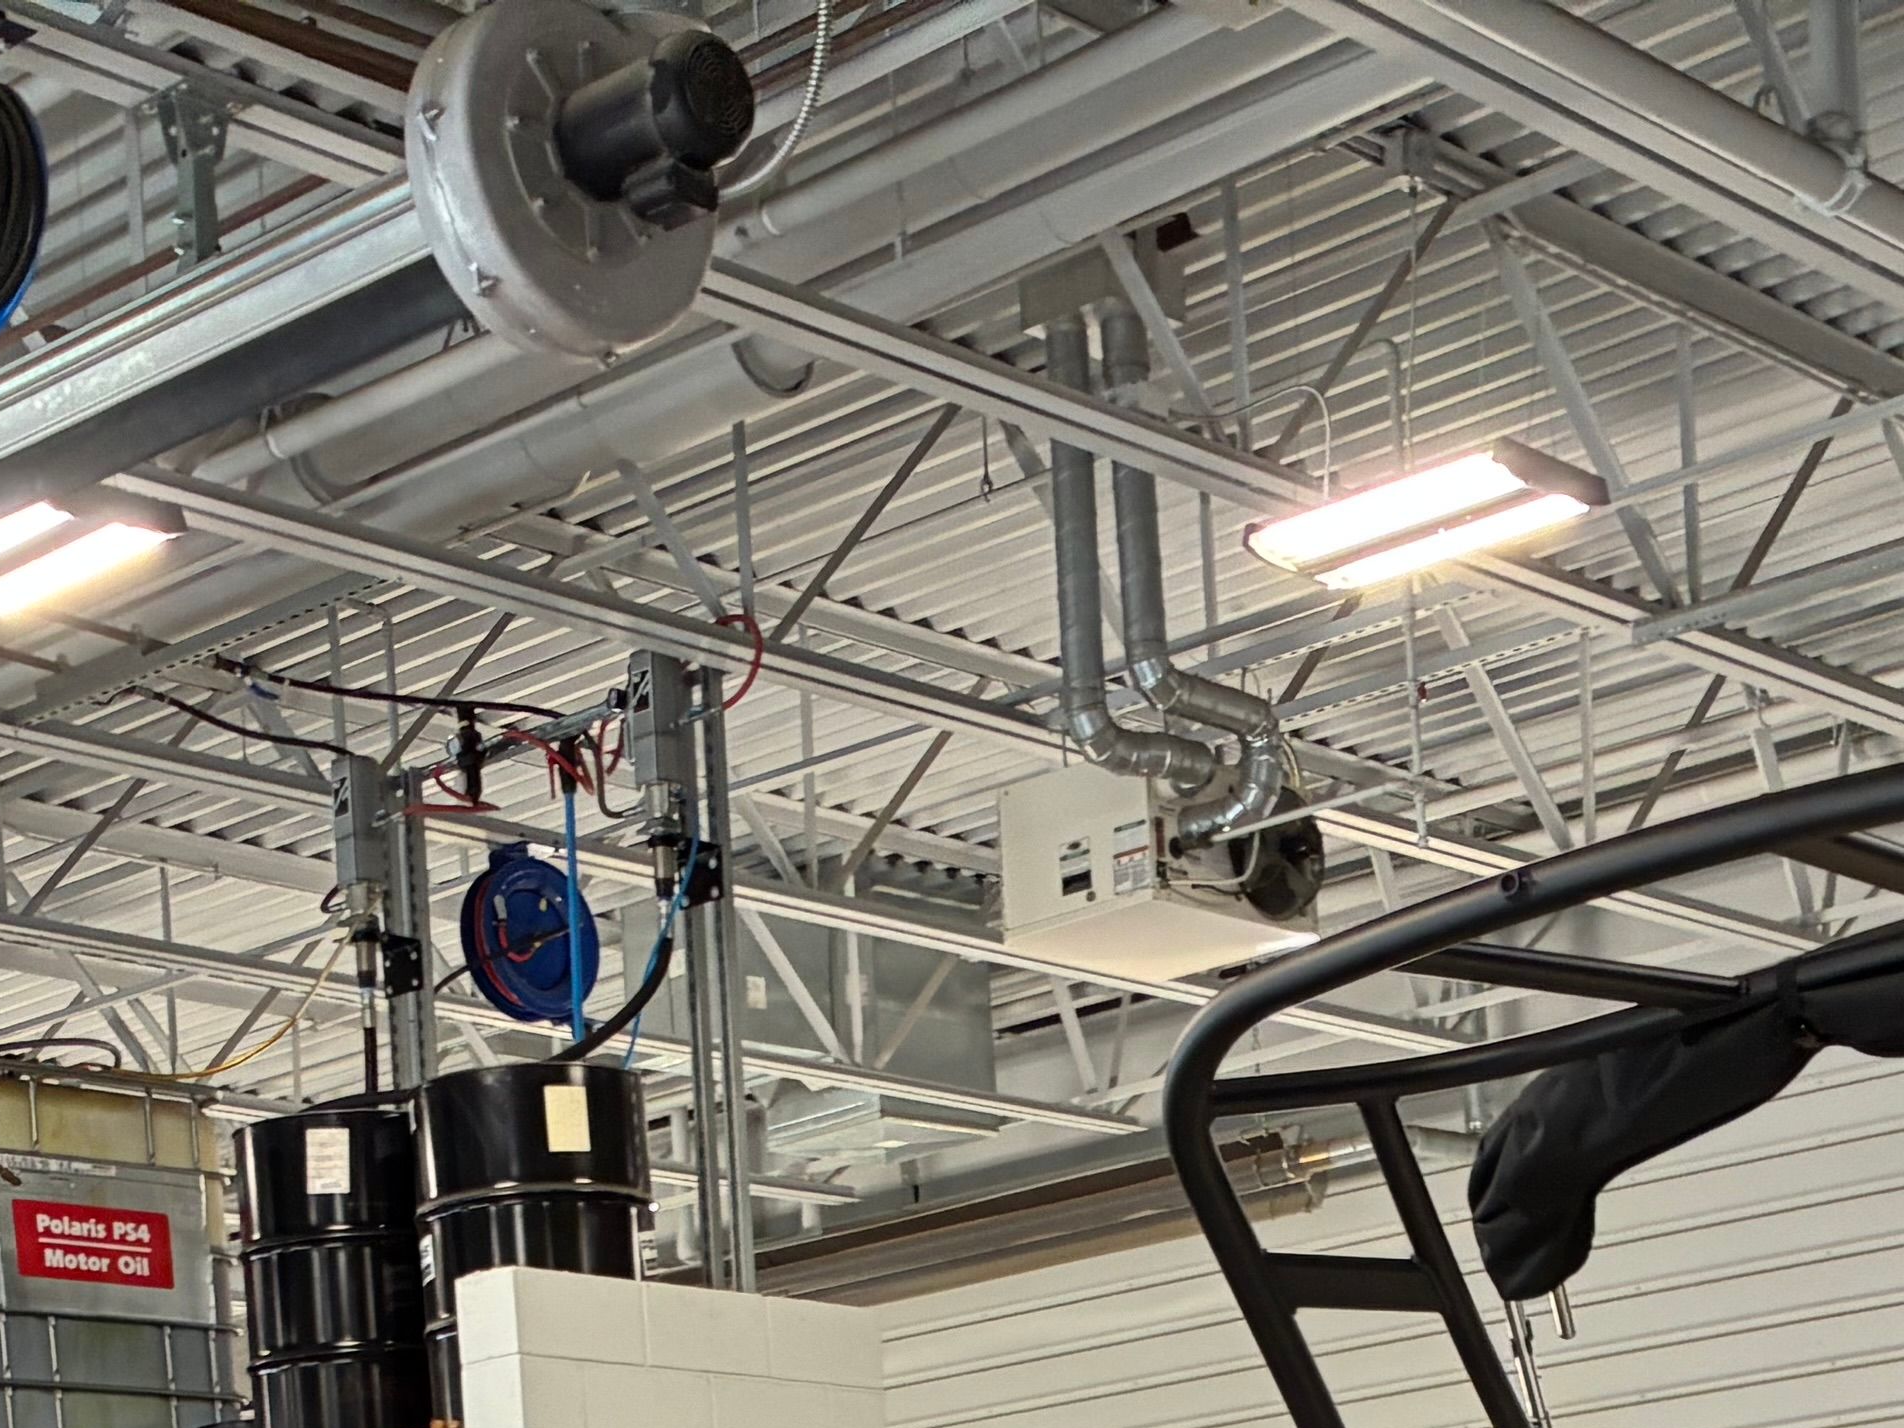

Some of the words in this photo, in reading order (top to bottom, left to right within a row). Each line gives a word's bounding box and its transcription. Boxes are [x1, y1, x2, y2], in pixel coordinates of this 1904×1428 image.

[36, 1213, 107, 1239] Polaris
[112, 1221, 151, 1244] PS4
[43, 1247, 110, 1272] Motor
[117, 1255, 150, 1277] Oil
